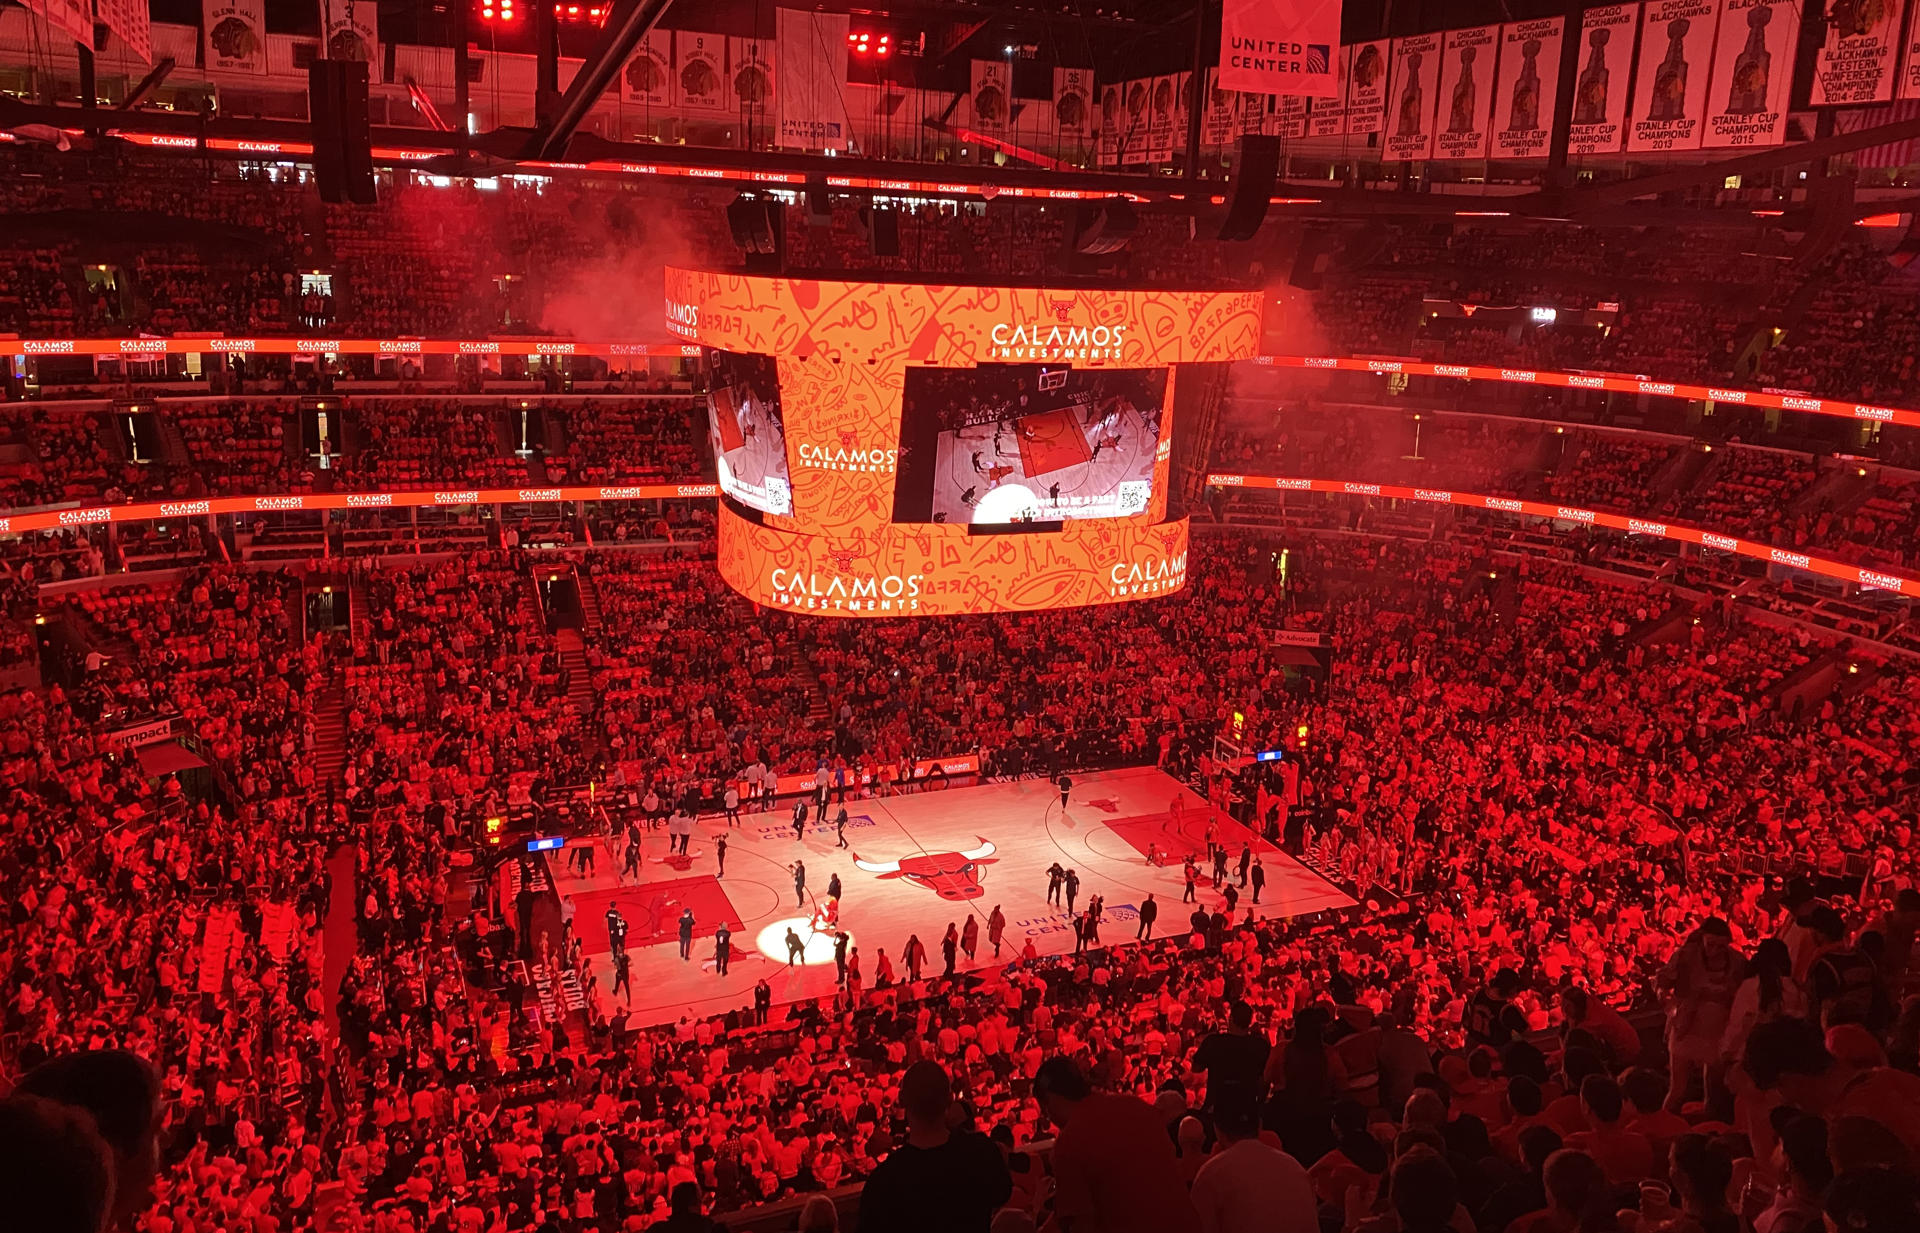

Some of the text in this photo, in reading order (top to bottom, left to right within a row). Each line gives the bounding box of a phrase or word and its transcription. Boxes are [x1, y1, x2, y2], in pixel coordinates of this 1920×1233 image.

[1584, 6, 1621, 19] CHICAGO
[1650, 6, 1711, 22] BLACKHAWKS
[1517, 21, 1551, 32] CHICAGO
[1584, 15, 1630, 27] ACKHAWKS
[1456, 29, 1485, 40] CHICAGO
[1508, 28, 1558, 42] BLACKHAWKS
[696, 38, 703, 49] 9
[1231, 36, 1302, 55] UNITED
[1449, 36, 1492, 49] BLACKHAWKS
[1838, 37, 1878, 50] CHICAGO
[1825, 46, 1888, 61] BLACKHAWKS
[1231, 55, 1301, 73] CENTER
[1831, 59, 1878, 70] WESTERN
[987, 66, 996, 77] 21
[1823, 68, 1883, 82] CONFERENCE
[1068, 73, 1079, 83] 35
[782, 120, 825, 129] UNITED
[1712, 113, 1779, 125] STANLEY CUP
[1569, 125, 1617, 135] ANLEY CUP
[1635, 119, 1696, 131] STANLEY CUP
[1715, 123, 1774, 135] CHAMPIONS
[782, 129, 825, 138] CENTER
[1439, 132, 1482, 141] STANLEY CUP
[1498, 130, 1547, 140] STANLEY CUP
[1569, 134, 1612, 144] HAMPIONS
[1638, 129, 1691, 140] CHAMPIONS
[152, 136, 197, 147] CALAMOS
[1388, 134, 1428, 145] STANLEY CUP
[1441, 140, 1478, 149] CHAMPIONS
[1500, 139, 1543, 148] CHAMPIONS
[1652, 140, 1673, 149] 2013
[1730, 135, 1754, 144] 2015
[1513, 148, 1529, 157] 1961
[1576, 145, 1595, 153] 2010
[689, 169, 723, 178] CALAMOS
[827, 177, 850, 186] LAMOS
[938, 184, 967, 193] CALAMOS
[992, 323, 1123, 346] CALAMOS
[211, 340, 255, 348] CALAMOS
[380, 341, 422, 349] CALAMOS
[460, 342, 499, 350] CALAMOS
[536, 343, 575, 351] CALAMOS
[991, 348, 1121, 358] INVESTMENTS
[1304, 358, 1337, 366] CALAMOS
[1368, 361, 1402, 370] CALAMOS
[1434, 365, 1469, 374] CALAMOS
[1501, 369, 1536, 379] CALAMOS
[1568, 376, 1604, 386] CALAMOS
[1639, 382, 1675, 392] CALAMOS
[1708, 389, 1746, 400] CALAMOS
[1782, 397, 1821, 408] CALAMOS
[1855, 406, 1894, 417] CALAMOS
[799, 444, 895, 465] CALAMOS
[799, 459, 894, 472] INVESTMENTS
[1210, 475, 1244, 483] CALAMOS
[1276, 479, 1312, 487] CALAMOS
[600, 488, 640, 496] CALAMOS
[677, 485, 716, 494] CALAMOS
[1344, 482, 1380, 492] CALAMOS
[347, 495, 392, 503] CALAMOS
[435, 492, 478, 501] CALAMOS
[519, 489, 561, 498] CALAMOS
[1415, 489, 1451, 500] CALAMOS
[255, 497, 303, 506] CALAMOS
[1486, 497, 1523, 509] CALAMOS
[160, 502, 210, 513] CALAMOS
[59, 508, 110, 521] CALAMOS
[1558, 508, 1596, 520] CALAMOS
[1629, 520, 1667, 532] CALAMOS
[1702, 533, 1738, 547] CALAMOS
[1771, 549, 1810, 565] CALAMOS
[771, 569, 919, 597] CALAMOS
[1111, 573, 1186, 597] INVESTMEN
[1858, 571, 1903, 588] CALAMOS
[772, 592, 918, 610] INVESTMENTS
[1285, 634, 1316, 643] Advocate
[1026, 918, 1110, 936] CENR
[563, 969, 585, 1012] BULLS
